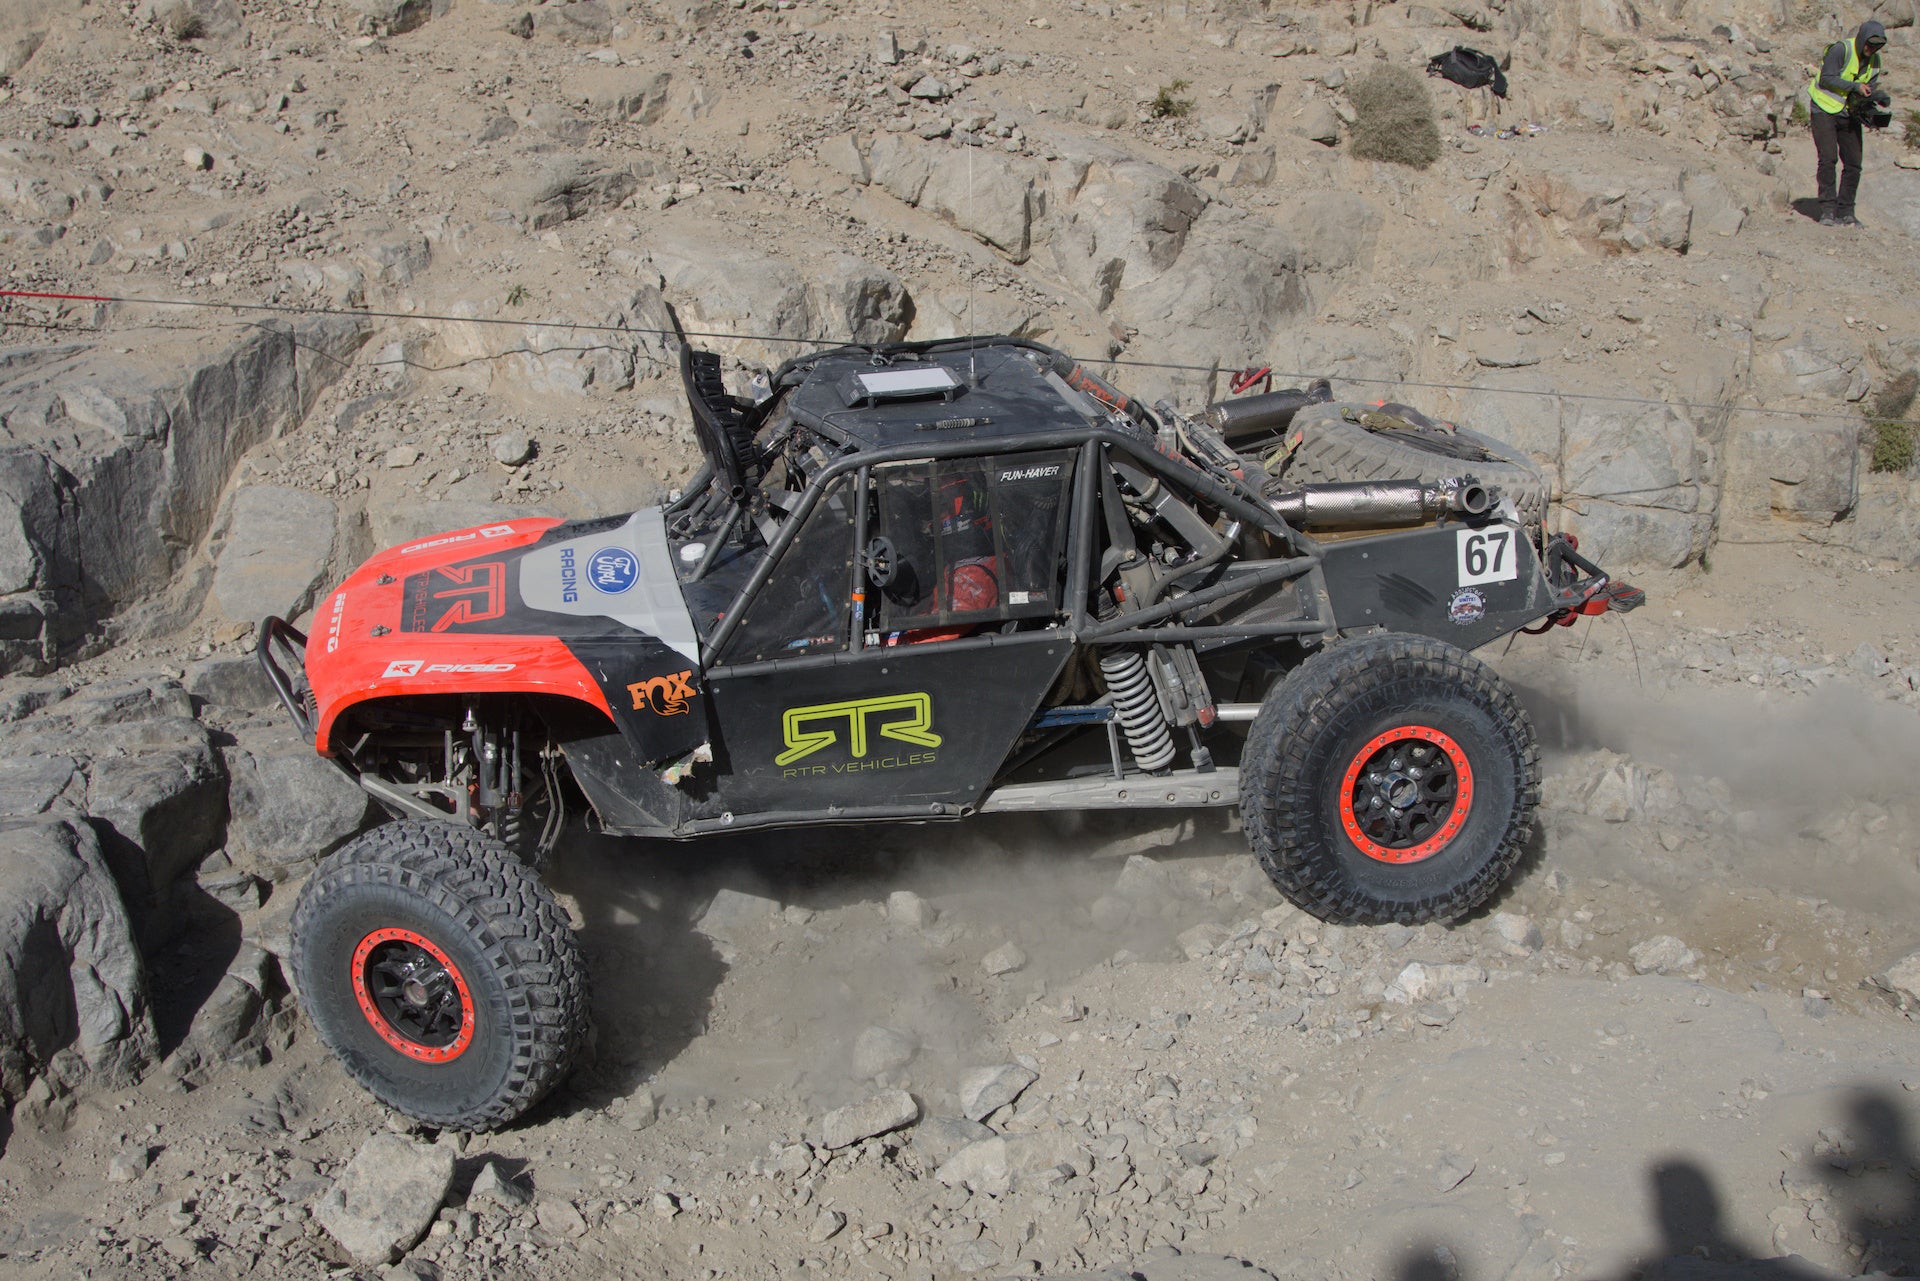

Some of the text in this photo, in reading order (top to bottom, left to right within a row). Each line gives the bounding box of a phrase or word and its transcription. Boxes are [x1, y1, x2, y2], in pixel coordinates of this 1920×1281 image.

[1000, 466, 1060, 482] FUN-HAVER
[401, 533, 477, 554] RIGID
[1465, 531, 1509, 576] 67
[560, 547, 578, 603] RACING
[596, 556, 631, 585] Ford
[423, 663, 517, 673] RIGID
[626, 669, 697, 716] FOX
[774, 691, 943, 767] RTR
[783, 752, 936, 779] RTR VEHICLES
